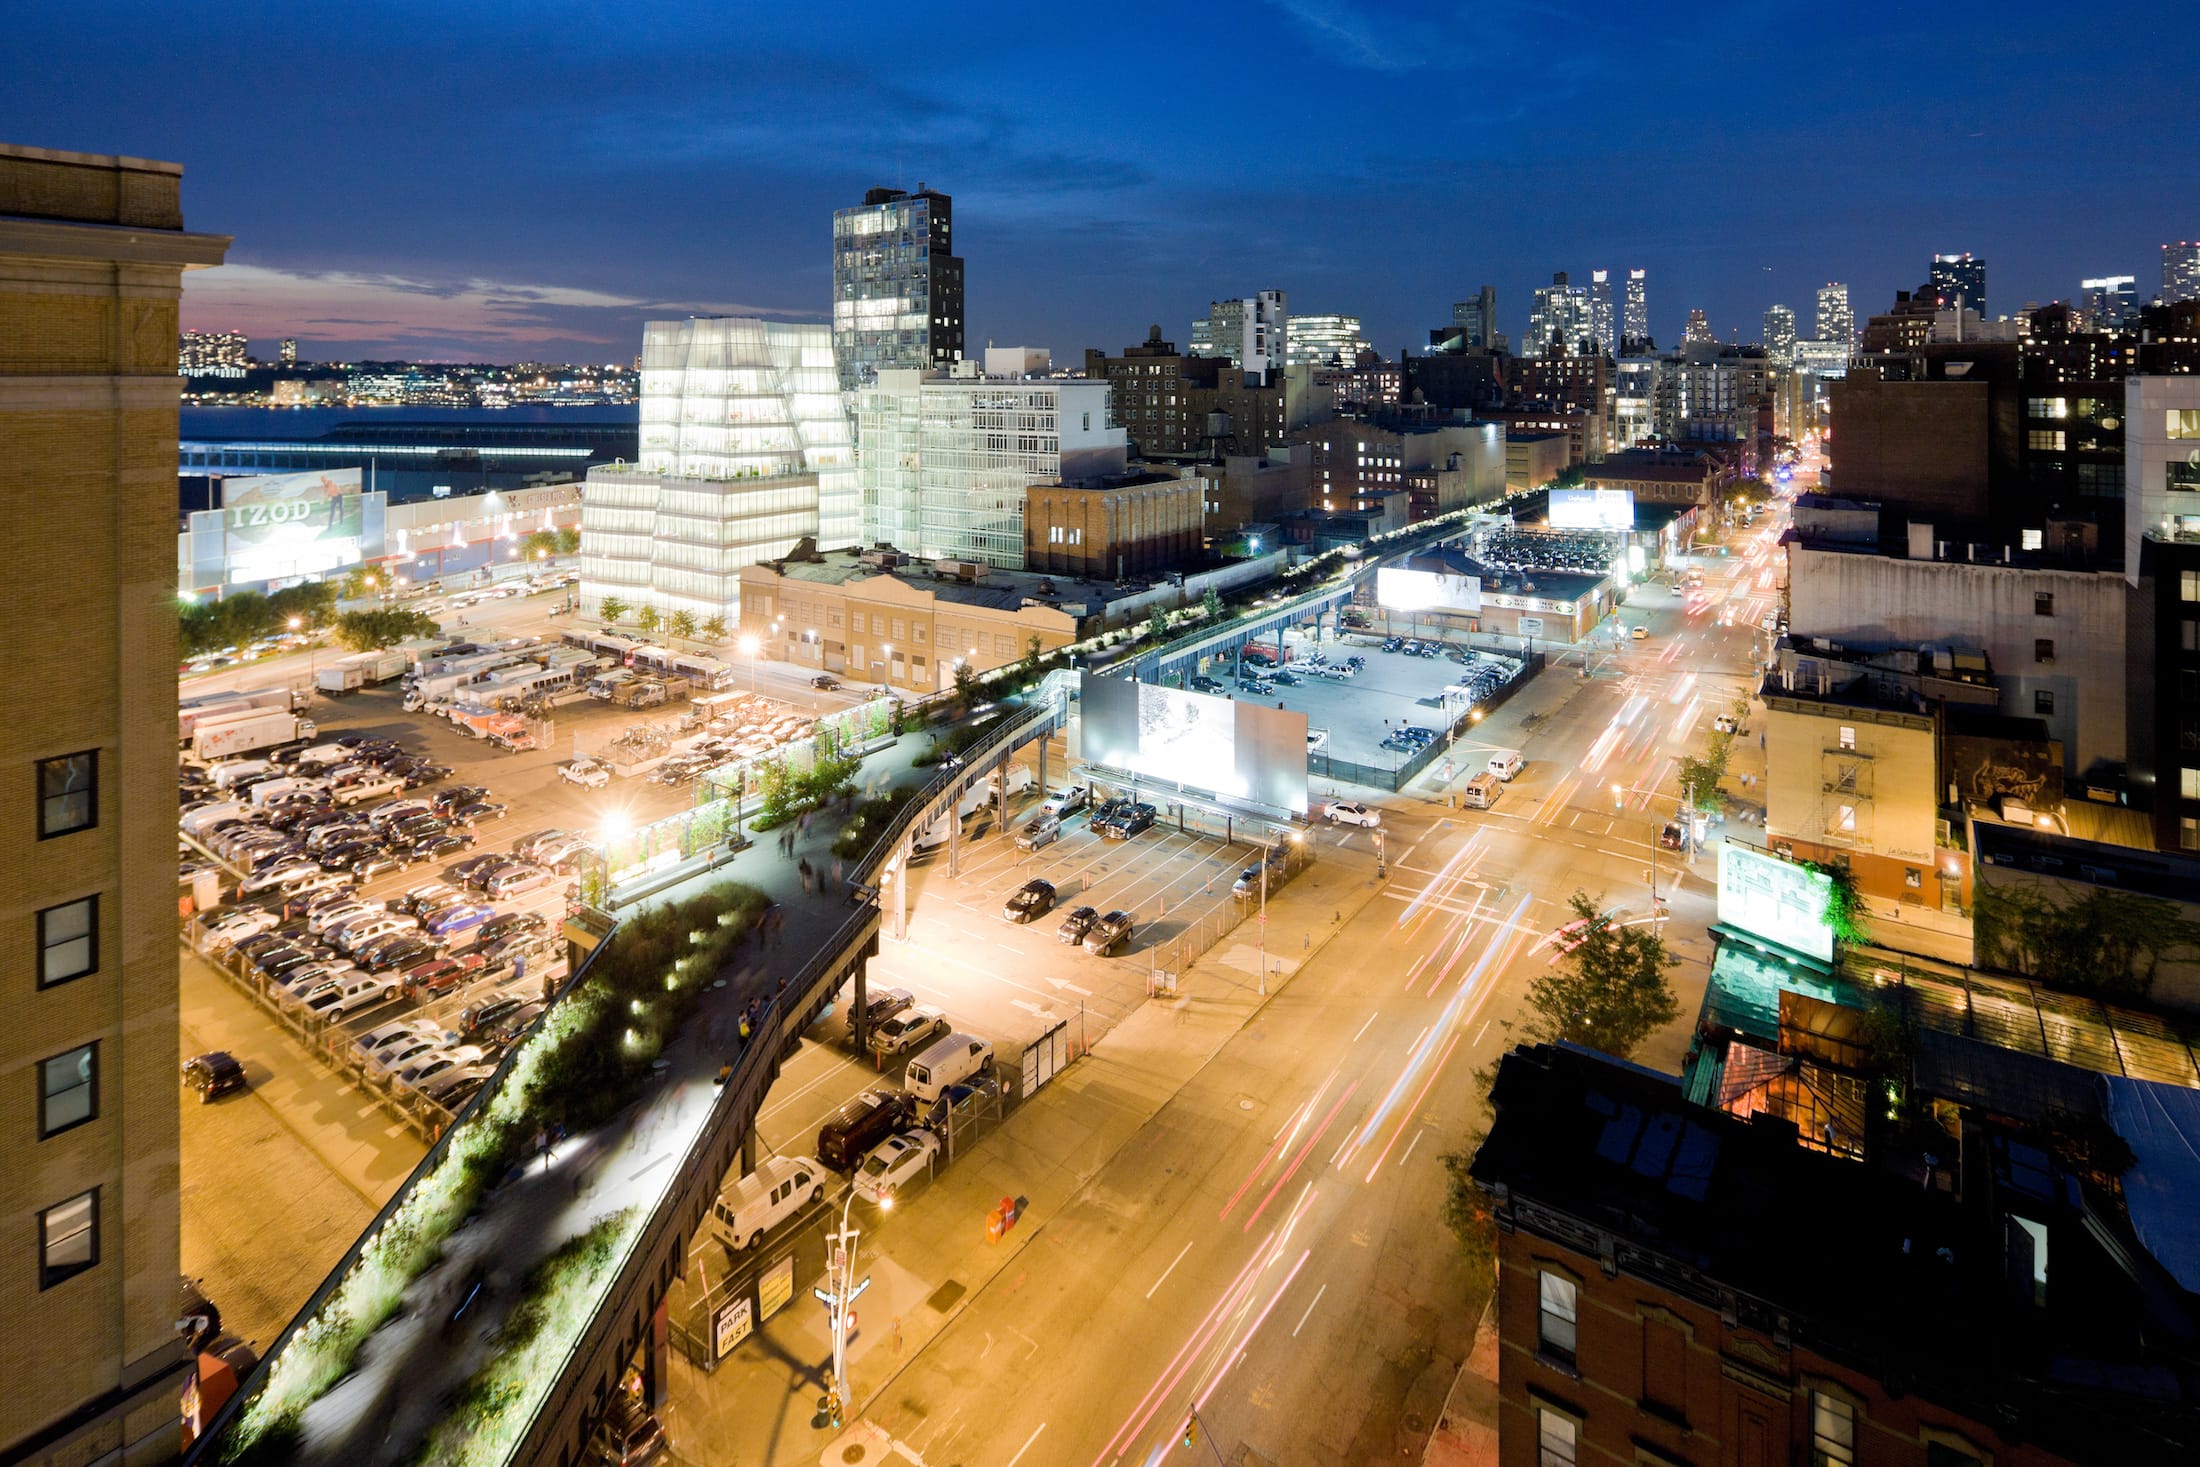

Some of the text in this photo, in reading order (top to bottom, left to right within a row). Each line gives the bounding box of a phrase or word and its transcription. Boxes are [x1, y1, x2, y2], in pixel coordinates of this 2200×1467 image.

[232, 499, 311, 528] IZOD
[1514, 598, 1553, 606] BUIING
[721, 1305, 747, 1334] PARK
[722, 1320, 747, 1350] FAST
